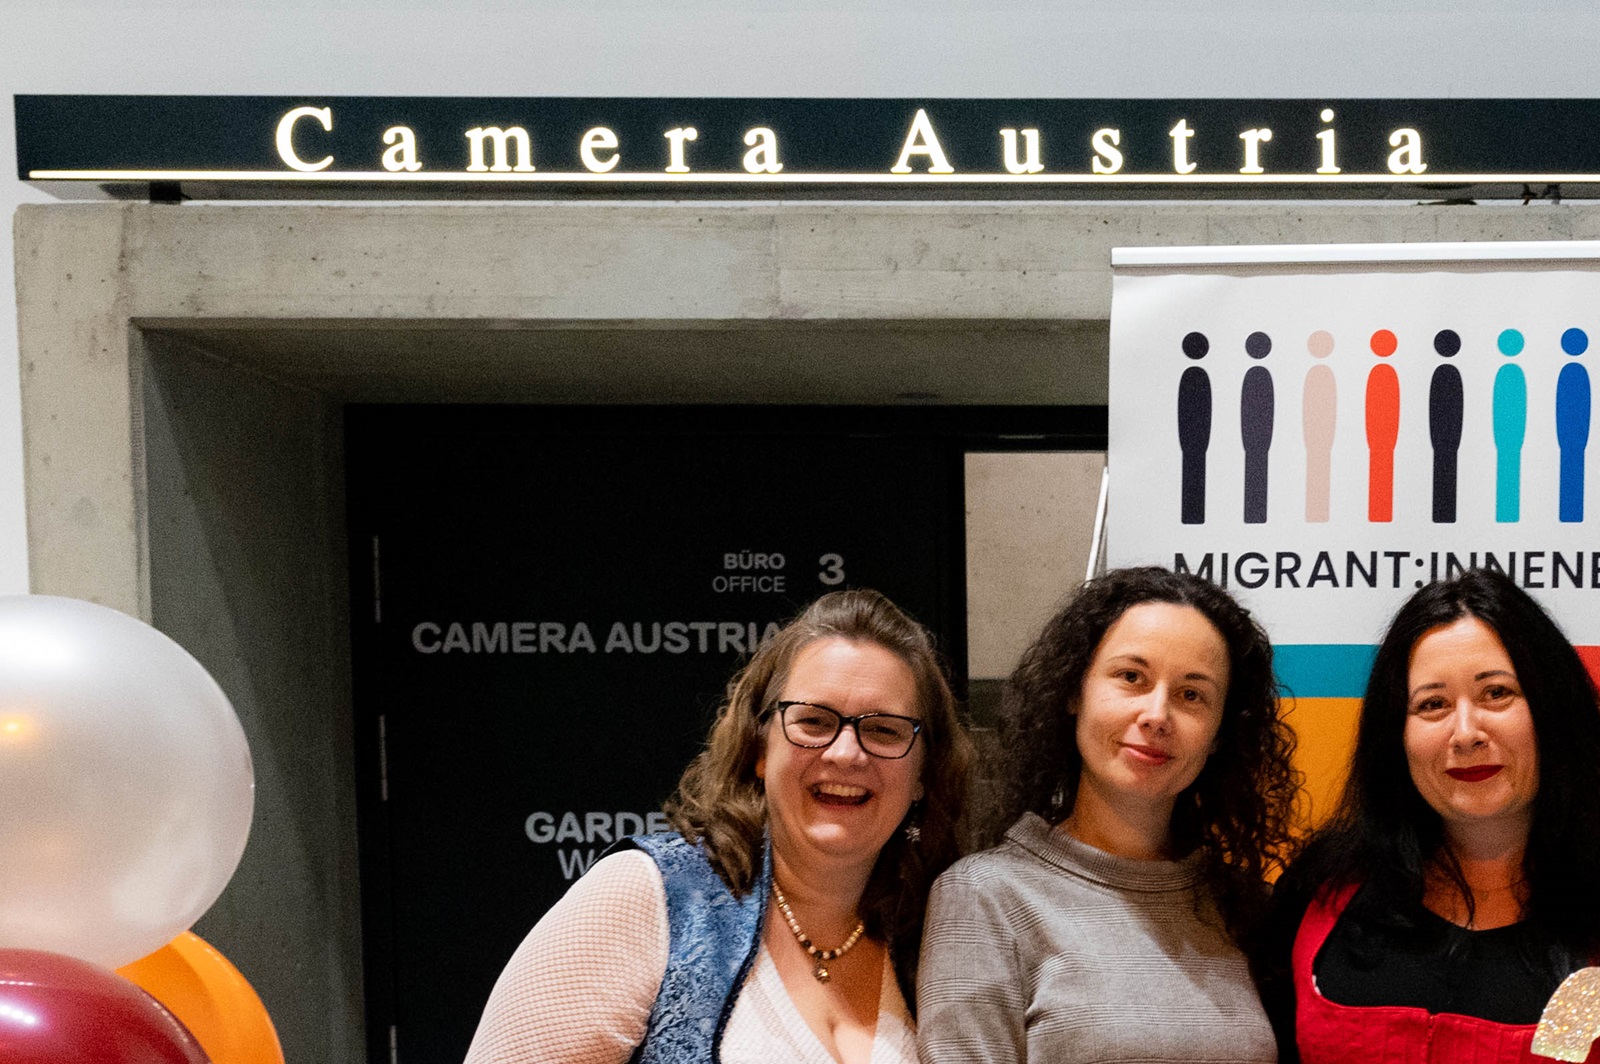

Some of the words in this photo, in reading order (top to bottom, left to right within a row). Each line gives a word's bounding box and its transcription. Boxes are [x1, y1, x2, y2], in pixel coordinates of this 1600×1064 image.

[275, 106, 784, 173] Camera
[891, 108, 1428, 174] Austria
[723, 549, 786, 570] BÜRO
[818, 553, 846, 586] 3
[712, 575, 786, 593] OFFICE
[411, 621, 597, 654] CAMERA
